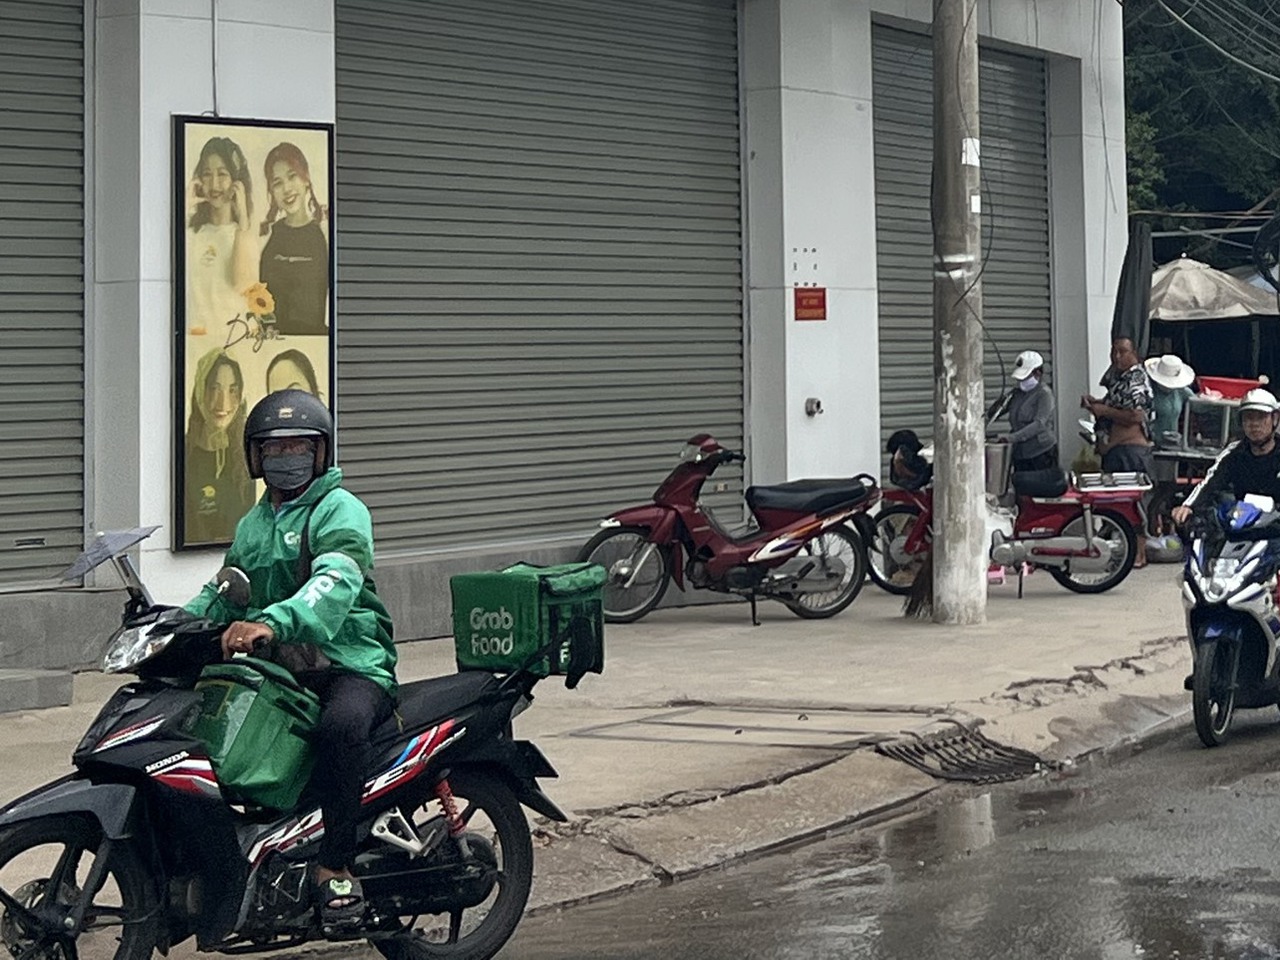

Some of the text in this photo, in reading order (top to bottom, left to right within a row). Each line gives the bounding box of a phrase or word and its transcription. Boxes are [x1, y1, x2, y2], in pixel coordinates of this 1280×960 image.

[470, 606, 513, 630] Grab
[471, 632, 513, 656] Food
[145, 750, 189, 773] HONDA
